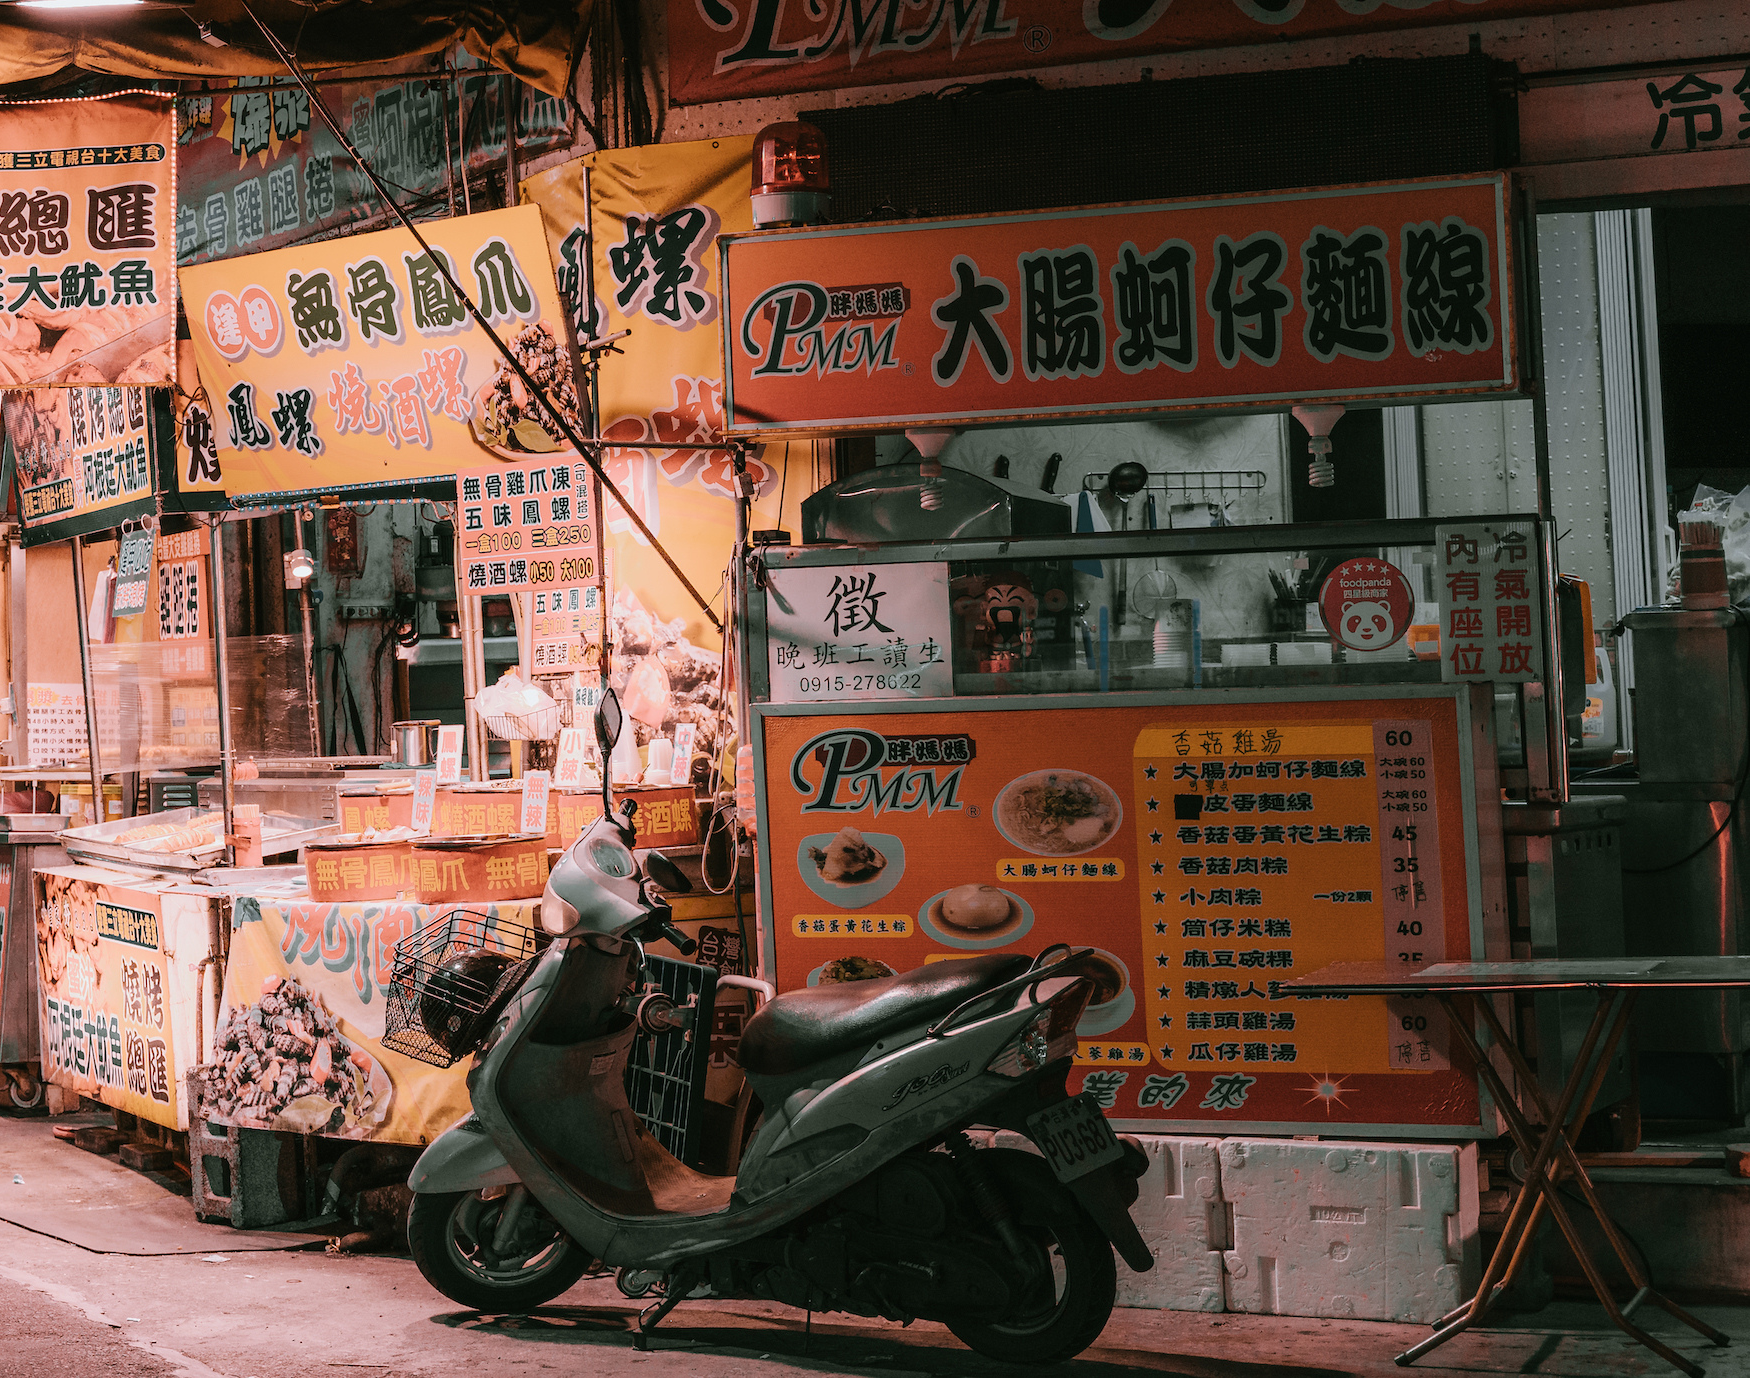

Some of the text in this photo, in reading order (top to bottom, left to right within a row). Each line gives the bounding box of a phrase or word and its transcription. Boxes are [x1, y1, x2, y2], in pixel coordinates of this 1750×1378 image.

[289, 240, 533, 348] 無骨鳳爪
[830, 287, 904, 315] 胖媽媽
[935, 225, 1489, 384] 大腸蚵仔麵線
[212, 298, 273, 347] 逢甲
[744, 283, 900, 377] PMM
[228, 382, 321, 455] 鳳螺
[329, 347, 474, 444] 燒酒螺
[83, 437, 148, 504] 阿根廷大魷魚
[463, 465, 571, 501] 無骨雞爪凍
[464, 497, 571, 530] 五味鳳螺
[466, 525, 591, 553] 一盒100 三盒250
[469, 557, 594, 588] 燒酒螺 小50 大100
[1340, 577, 1391, 589] foodpanda
[535, 587, 597, 614] 五味鳳螺
[824, 572, 895, 637] 徵
[1446, 533, 1485, 675] 內有座位
[1493, 531, 1534, 674] 冷氣開放
[777, 637, 945, 670] 晚班工讀生
[800, 674, 921, 692] 0915-278622
[887, 738, 970, 762] 胖媽媽
[1385, 730, 1413, 746] 60
[562, 732, 581, 782] 小辣
[672, 734, 692, 780] 中辣
[1173, 757, 1425, 781] 大腸加蚵仔麵線 大碗60
[792, 728, 965, 816] PMM
[1380, 769, 1426, 780] 小碗50
[526, 776, 544, 828] 無辣
[1204, 789, 1427, 813] 皮蛋麵線 大碗60
[1382, 802, 1427, 812] 小碗50
[1176, 825, 1417, 844] 香菇蛋黃花生粽 45
[1003, 863, 1118, 877] 大腸蚵仔麵線
[1178, 857, 1419, 875] 香菇肉粽 35
[1179, 888, 1373, 906] 小肉粽 一份2顆
[797, 919, 906, 933] 香菇蛋黃花生粽
[1181, 919, 1423, 938] 筒仔米糕 40
[1182, 950, 1294, 968] 麻豆碗粿
[122, 957, 164, 1032] 燒烤
[1184, 980, 1349, 1001] 精燉人蔘
[1186, 1011, 1427, 1031] 蒜頭雞湯 60
[48, 998, 125, 1088] 阿根廷大魷魚
[1188, 1041, 1297, 1062] 瓜仔雞湯
[127, 1032, 169, 1103] 總匯
